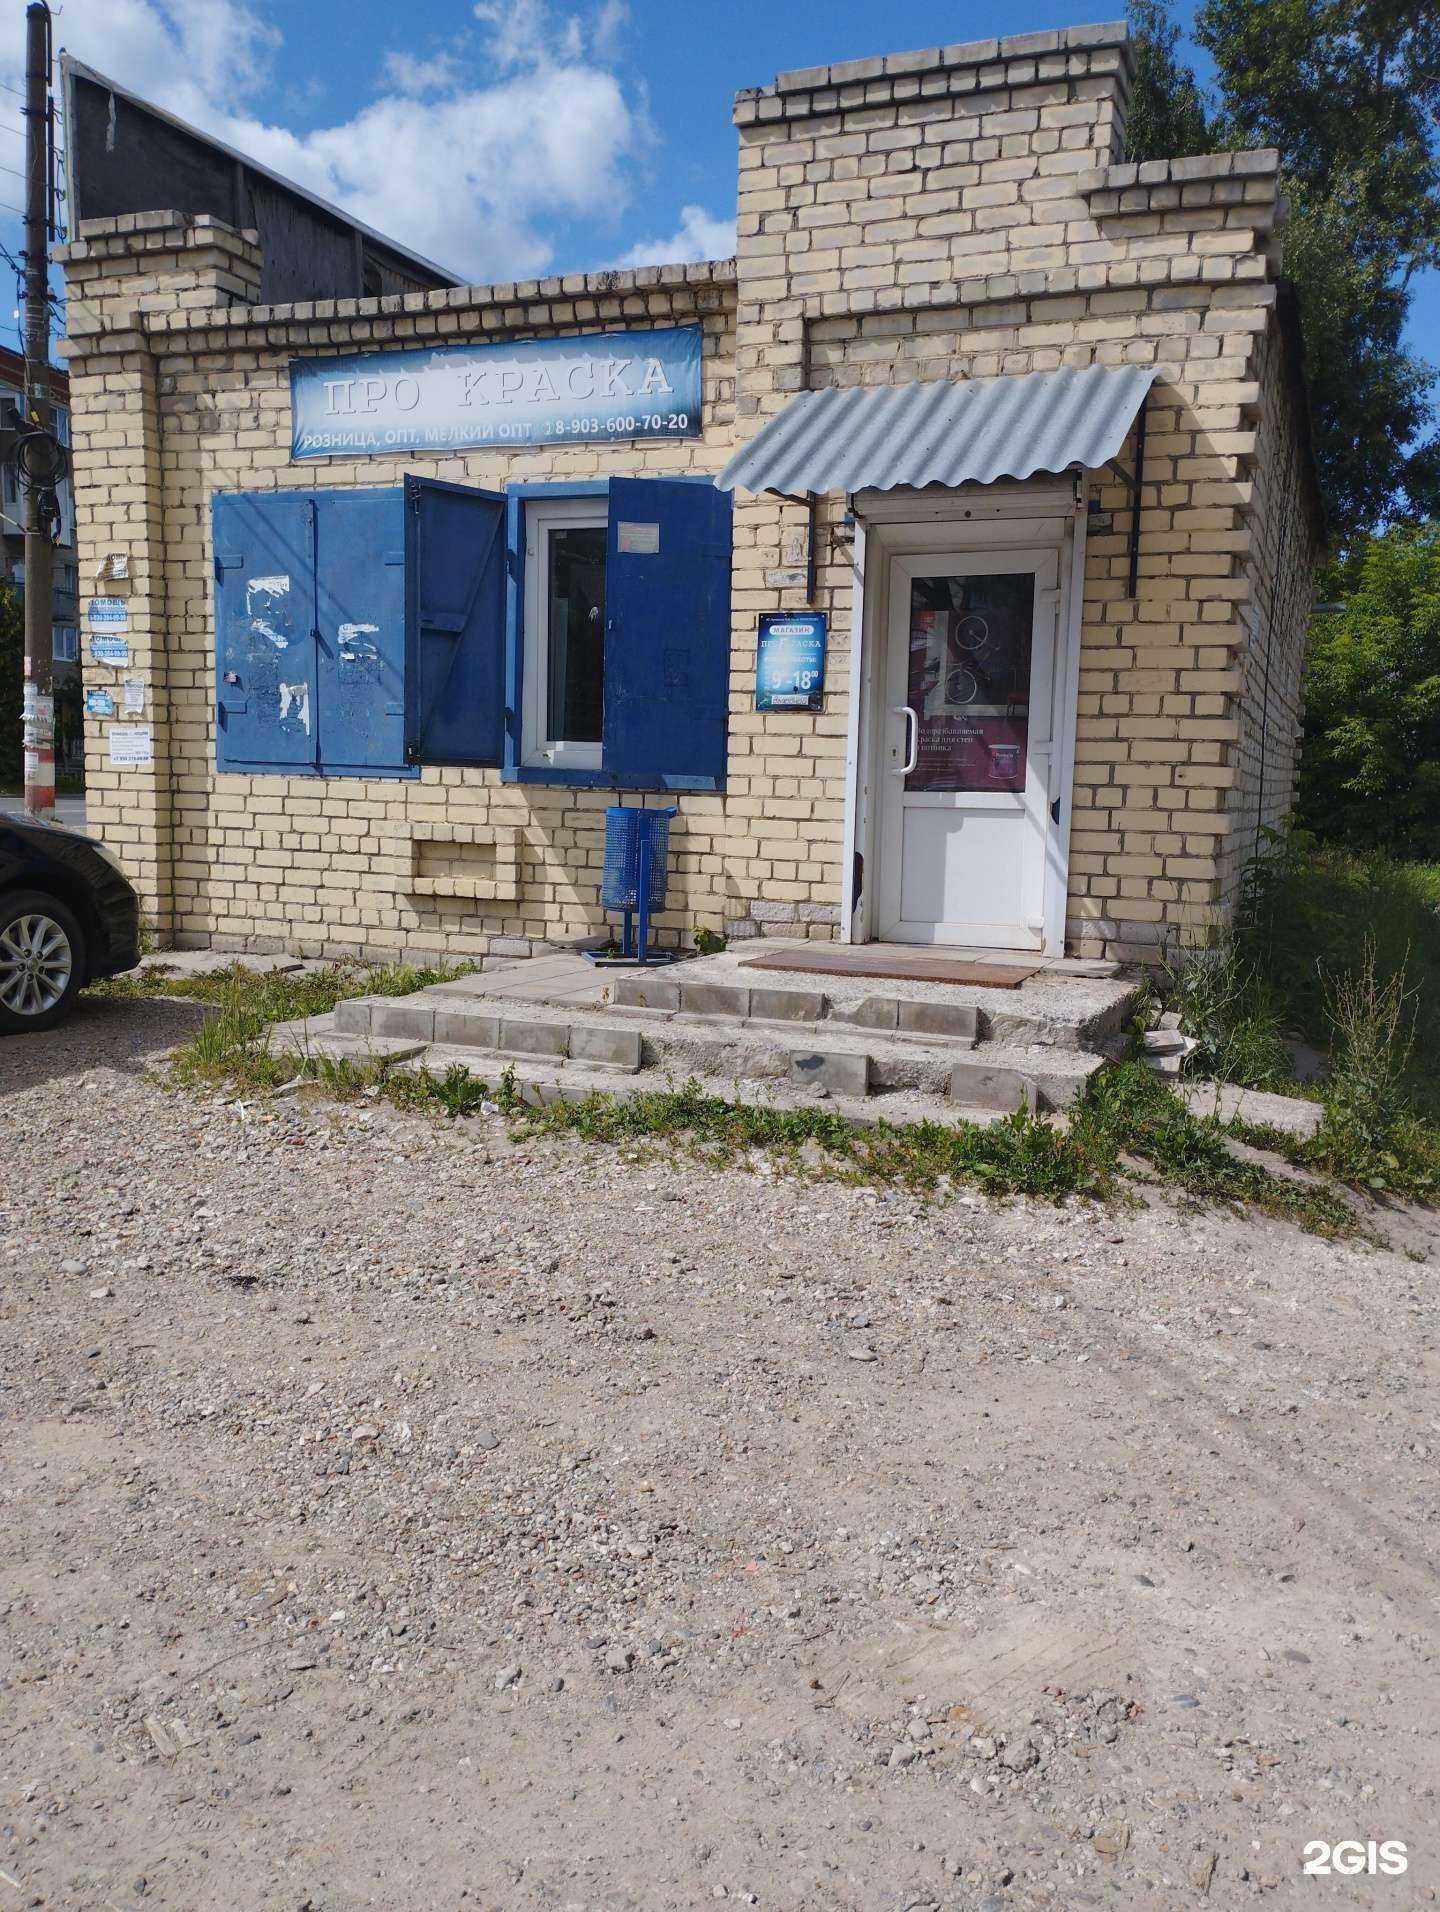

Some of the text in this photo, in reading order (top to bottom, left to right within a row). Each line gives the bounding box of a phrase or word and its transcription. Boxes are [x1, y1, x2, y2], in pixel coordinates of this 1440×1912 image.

[323, 357, 674, 415] ПРО КРАСКА
[385, 428, 419, 444] ОПТ,
[500, 423, 532, 437] ОПТ
[555, 413, 688, 434] 8-903-600-70-20
